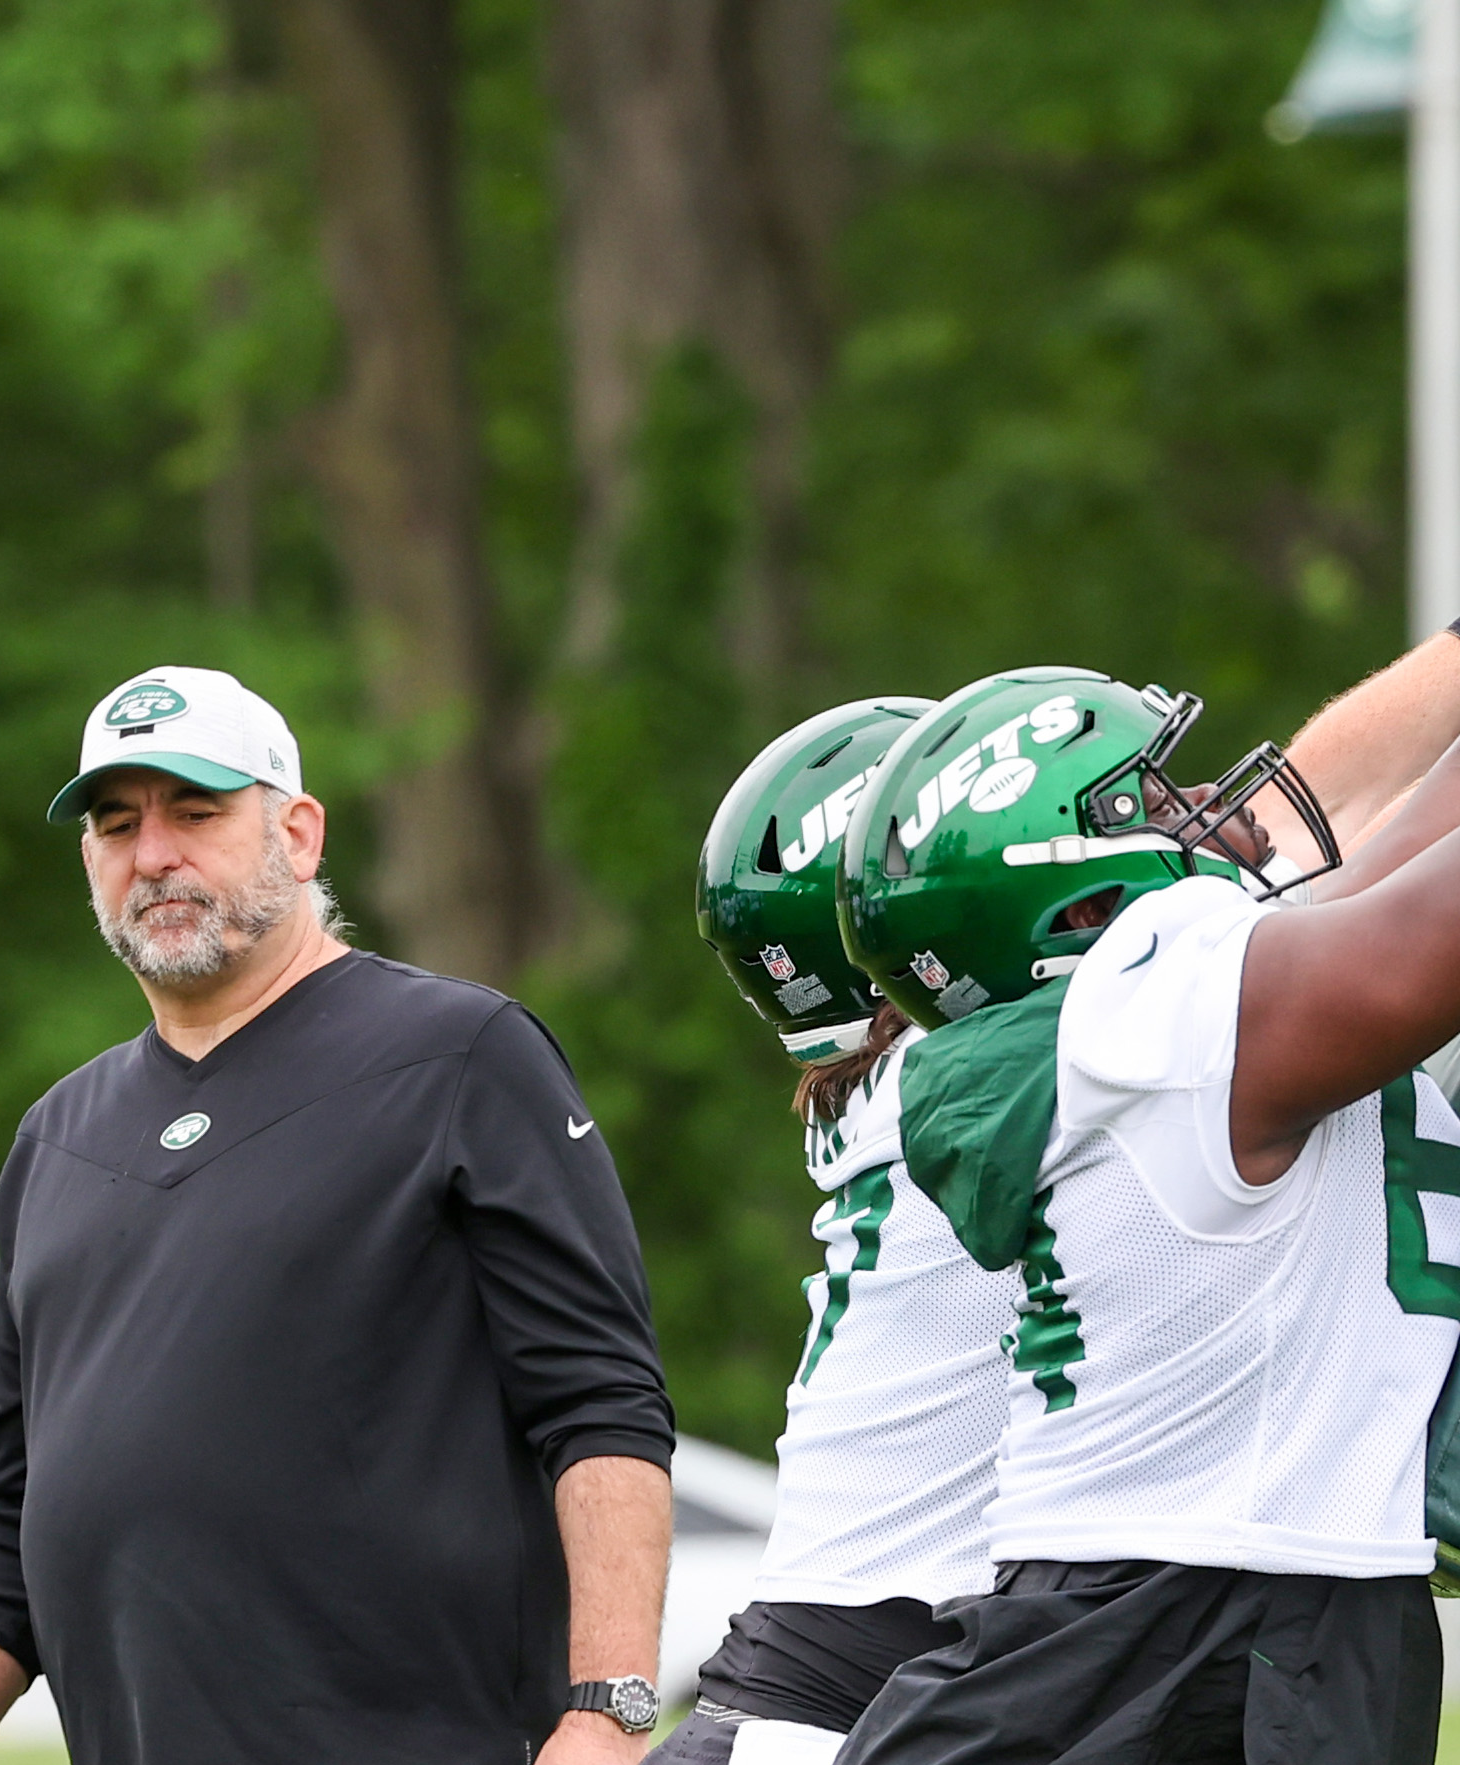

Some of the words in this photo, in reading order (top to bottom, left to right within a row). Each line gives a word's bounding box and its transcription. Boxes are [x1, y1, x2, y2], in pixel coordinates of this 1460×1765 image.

[110, 698, 177, 721] JETS
[900, 695, 1079, 849] JETS
[769, 959, 793, 977] NFL
[923, 965, 944, 986] NFL
